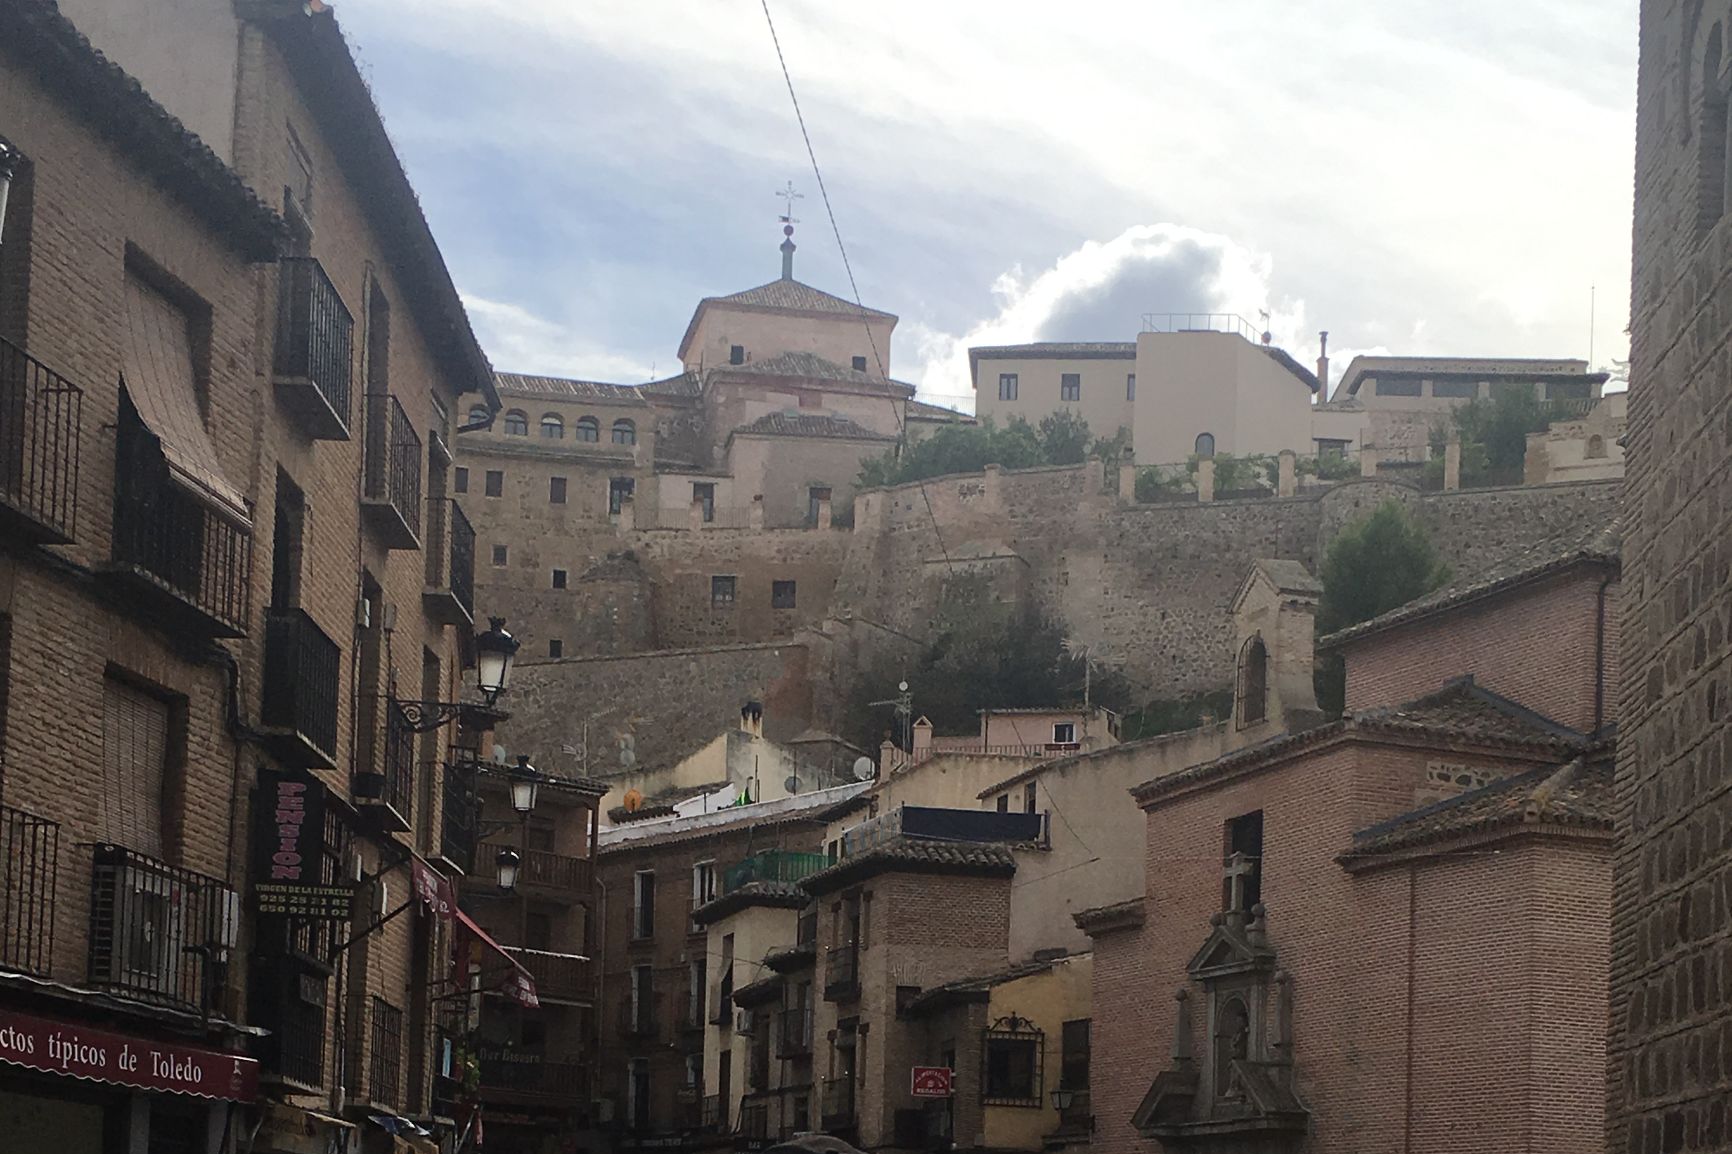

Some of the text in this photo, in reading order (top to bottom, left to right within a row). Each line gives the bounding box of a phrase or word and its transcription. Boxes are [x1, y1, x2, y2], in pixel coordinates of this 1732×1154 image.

[271, 781, 307, 880] PENSION
[255, 884, 288, 893] VIRGEN
[288, 885, 301, 894] DE
[47, 1031, 107, 1069] típicos
[118, 1044, 138, 1072] de
[149, 1050, 203, 1084] Toledo
